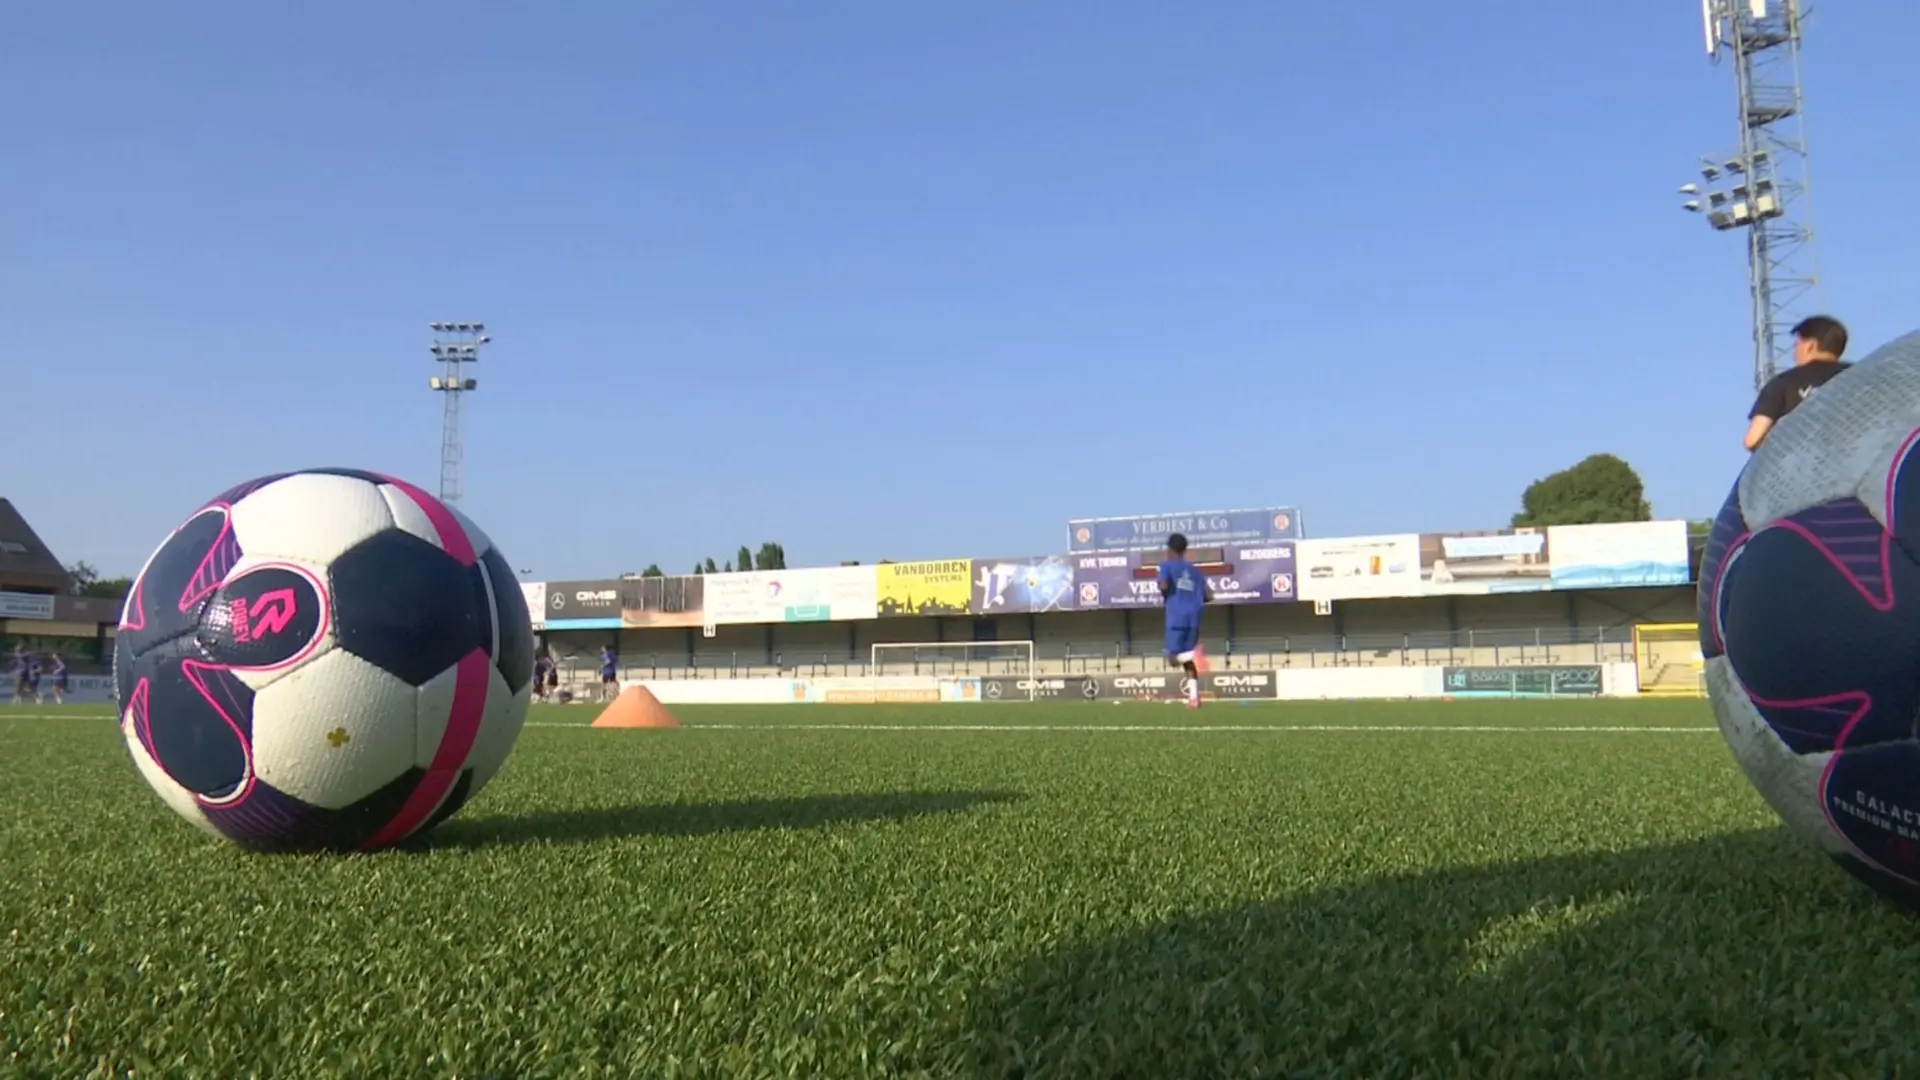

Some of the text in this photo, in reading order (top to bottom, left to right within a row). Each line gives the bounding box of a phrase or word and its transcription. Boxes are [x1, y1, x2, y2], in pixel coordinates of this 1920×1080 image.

[1132, 516, 1194, 534] VERBIEST
[1210, 516, 1228, 530] Co
[894, 561, 968, 576] VANBORREN
[1220, 576, 1240, 590] Co
